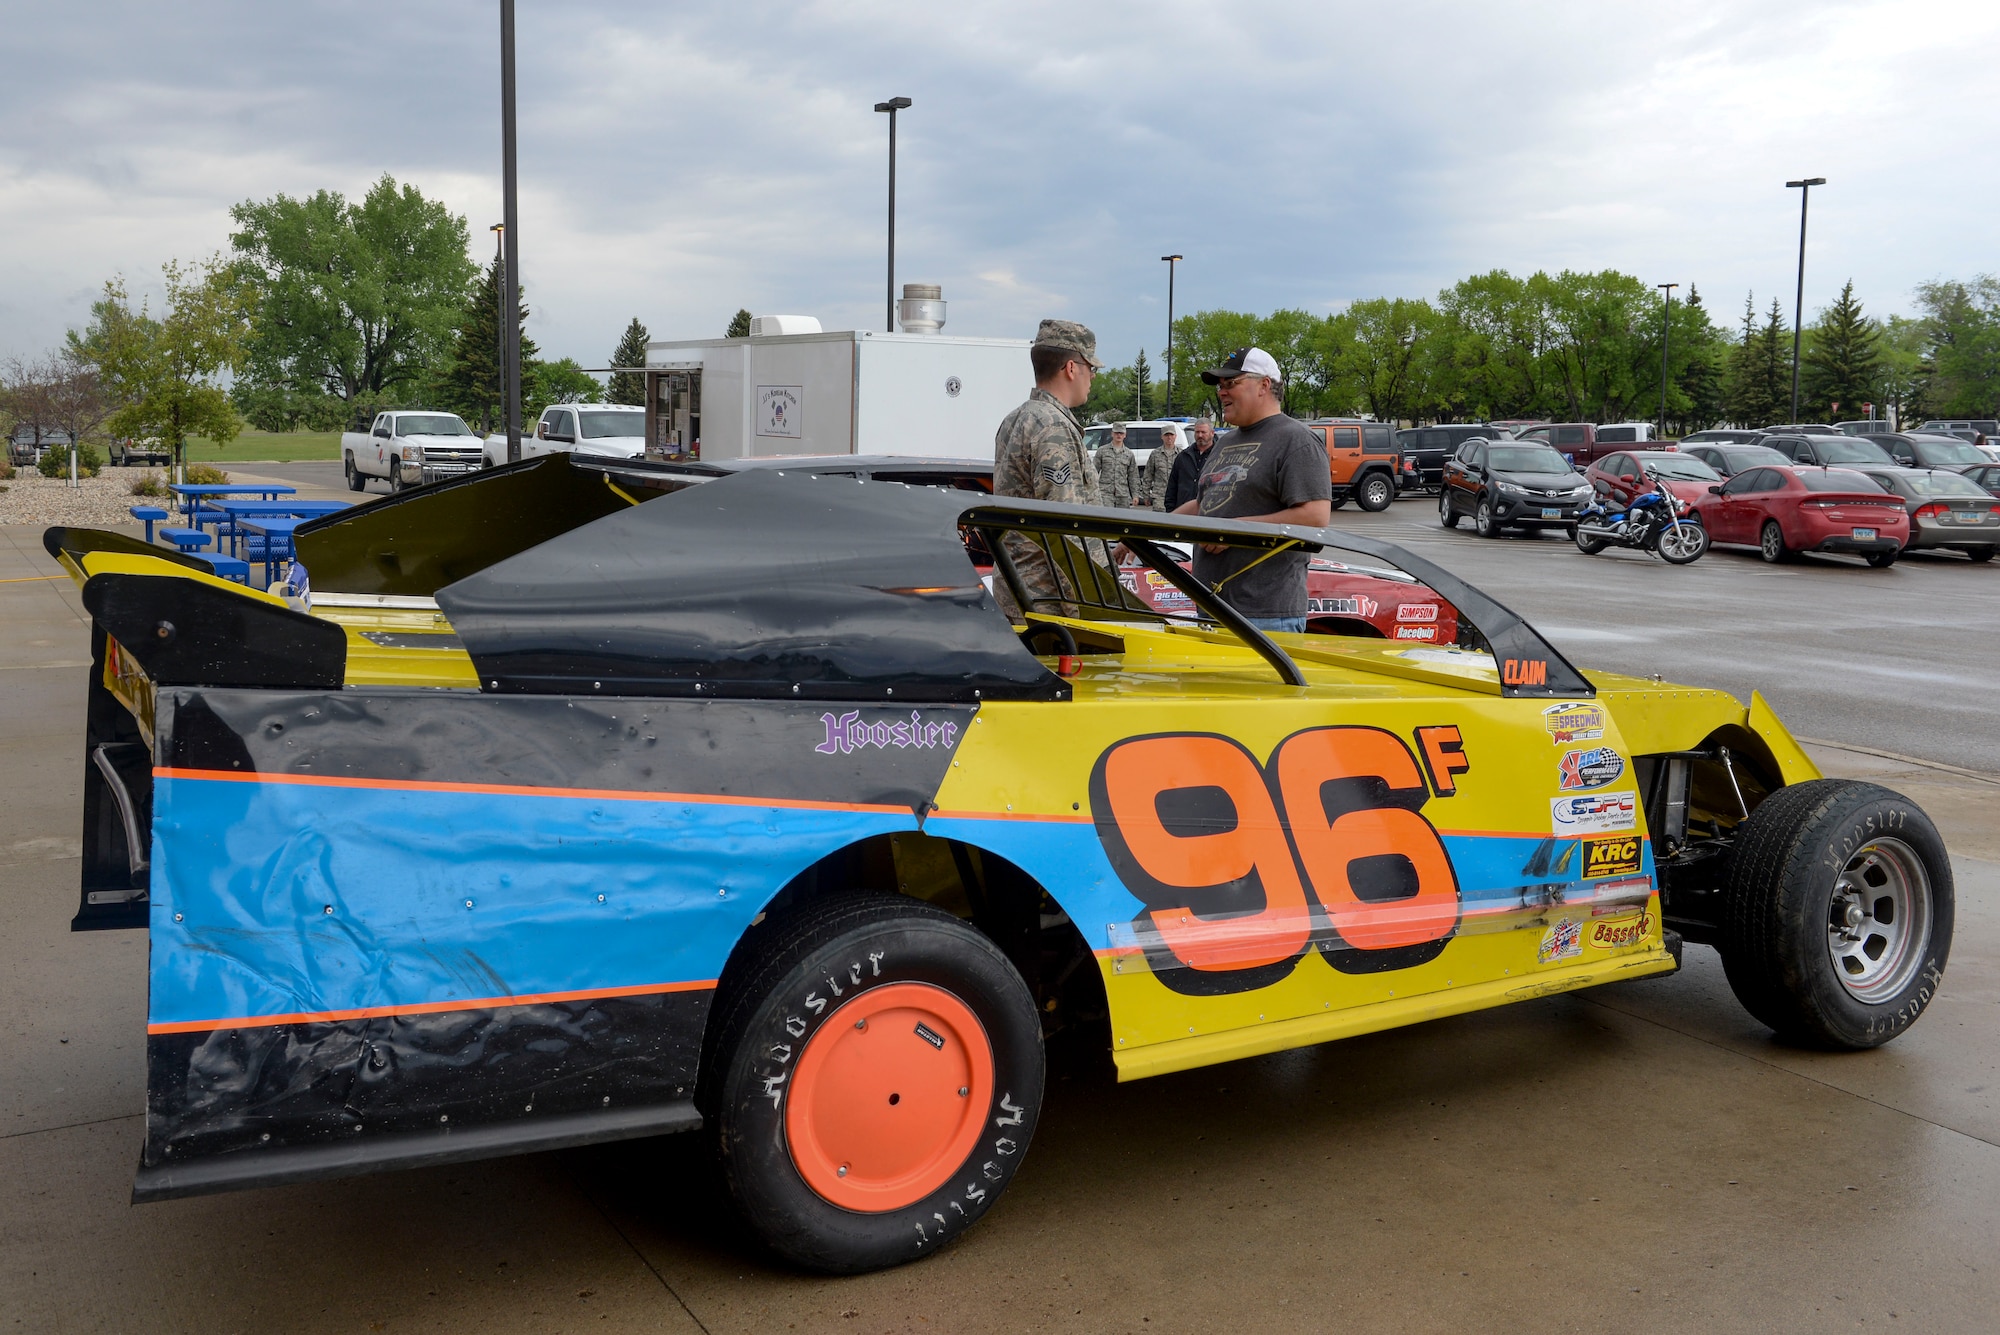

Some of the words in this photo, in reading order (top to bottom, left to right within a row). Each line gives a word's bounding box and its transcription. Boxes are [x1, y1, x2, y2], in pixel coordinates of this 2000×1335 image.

[1154, 591, 1170, 601] BIG
[1400, 607, 1434, 619] SIMPSON
[1396, 626, 1435, 639] RaceQuip
[1503, 659, 1547, 686] CLAIM
[815, 709, 958, 754] Hoosier
[1560, 714, 1601, 729] SPEEDWAY
[1581, 767, 1620, 776] PERFORMANCE
[1571, 794, 1634, 815] SDPC
[1823, 807, 1908, 875] Hoosier
[1589, 842, 1637, 864] KRC
[1593, 918, 1650, 943] Bassett
